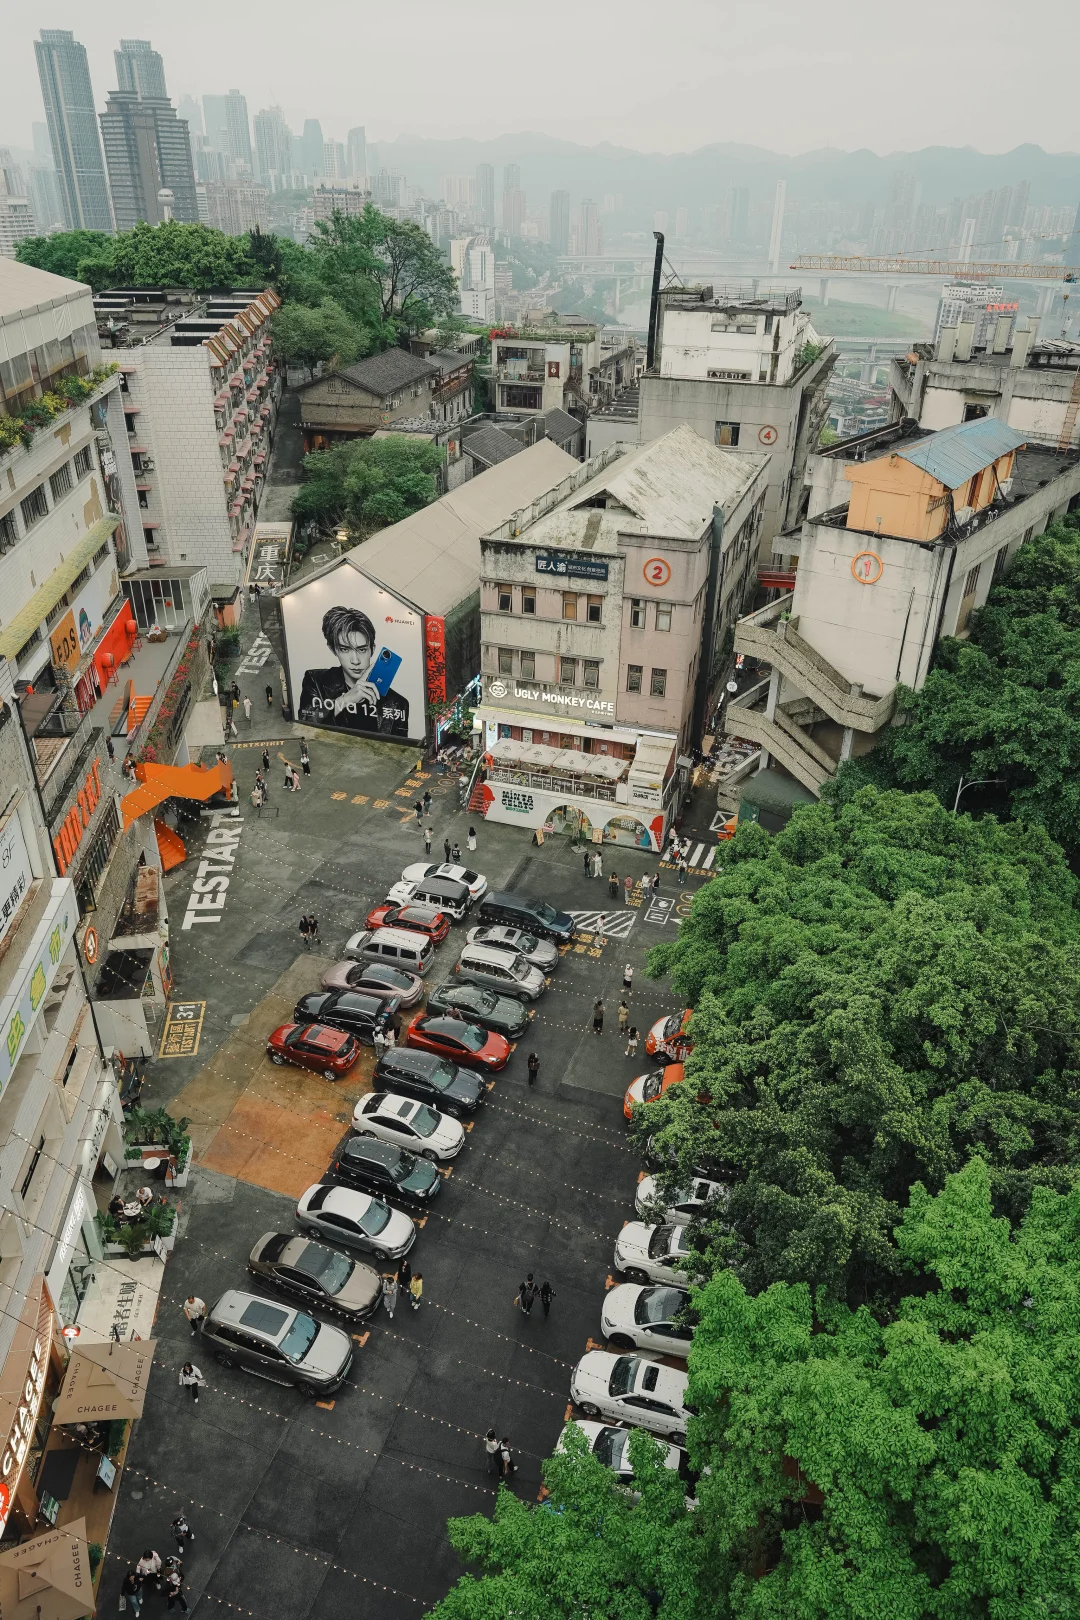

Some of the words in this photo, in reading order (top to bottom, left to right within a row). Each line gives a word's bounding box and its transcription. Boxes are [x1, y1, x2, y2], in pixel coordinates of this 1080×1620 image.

[763, 430, 772, 440] 4
[255, 545, 280, 580] 重庆
[537, 560, 566, 573] 匠人渝
[652, 566, 663, 579] 2
[864, 561, 871, 576] 1
[312, 696, 358, 714] nova
[361, 704, 378, 718] 12
[382, 707, 406, 722] 系列
[514, 688, 540, 701] UGLY
[542, 692, 585, 708] MONKEY
[586, 700, 614, 712] CAFE
[501, 798, 534, 810] GELATO
[181, 814, 245, 930] TESTART
[177, 1005, 196, 1019] 31
[180, 1023, 197, 1052] TESTART
[66, 1362, 80, 1400] CHAGEE
[131, 1358, 144, 1395] CHAGEE
[3, 1338, 42, 1476] CHAGEE
[77, 1404, 118, 1413] CHAGEE
[13, 1535, 60, 1559] CHAGEE
[71, 1543, 83, 1588] CHAGEE
